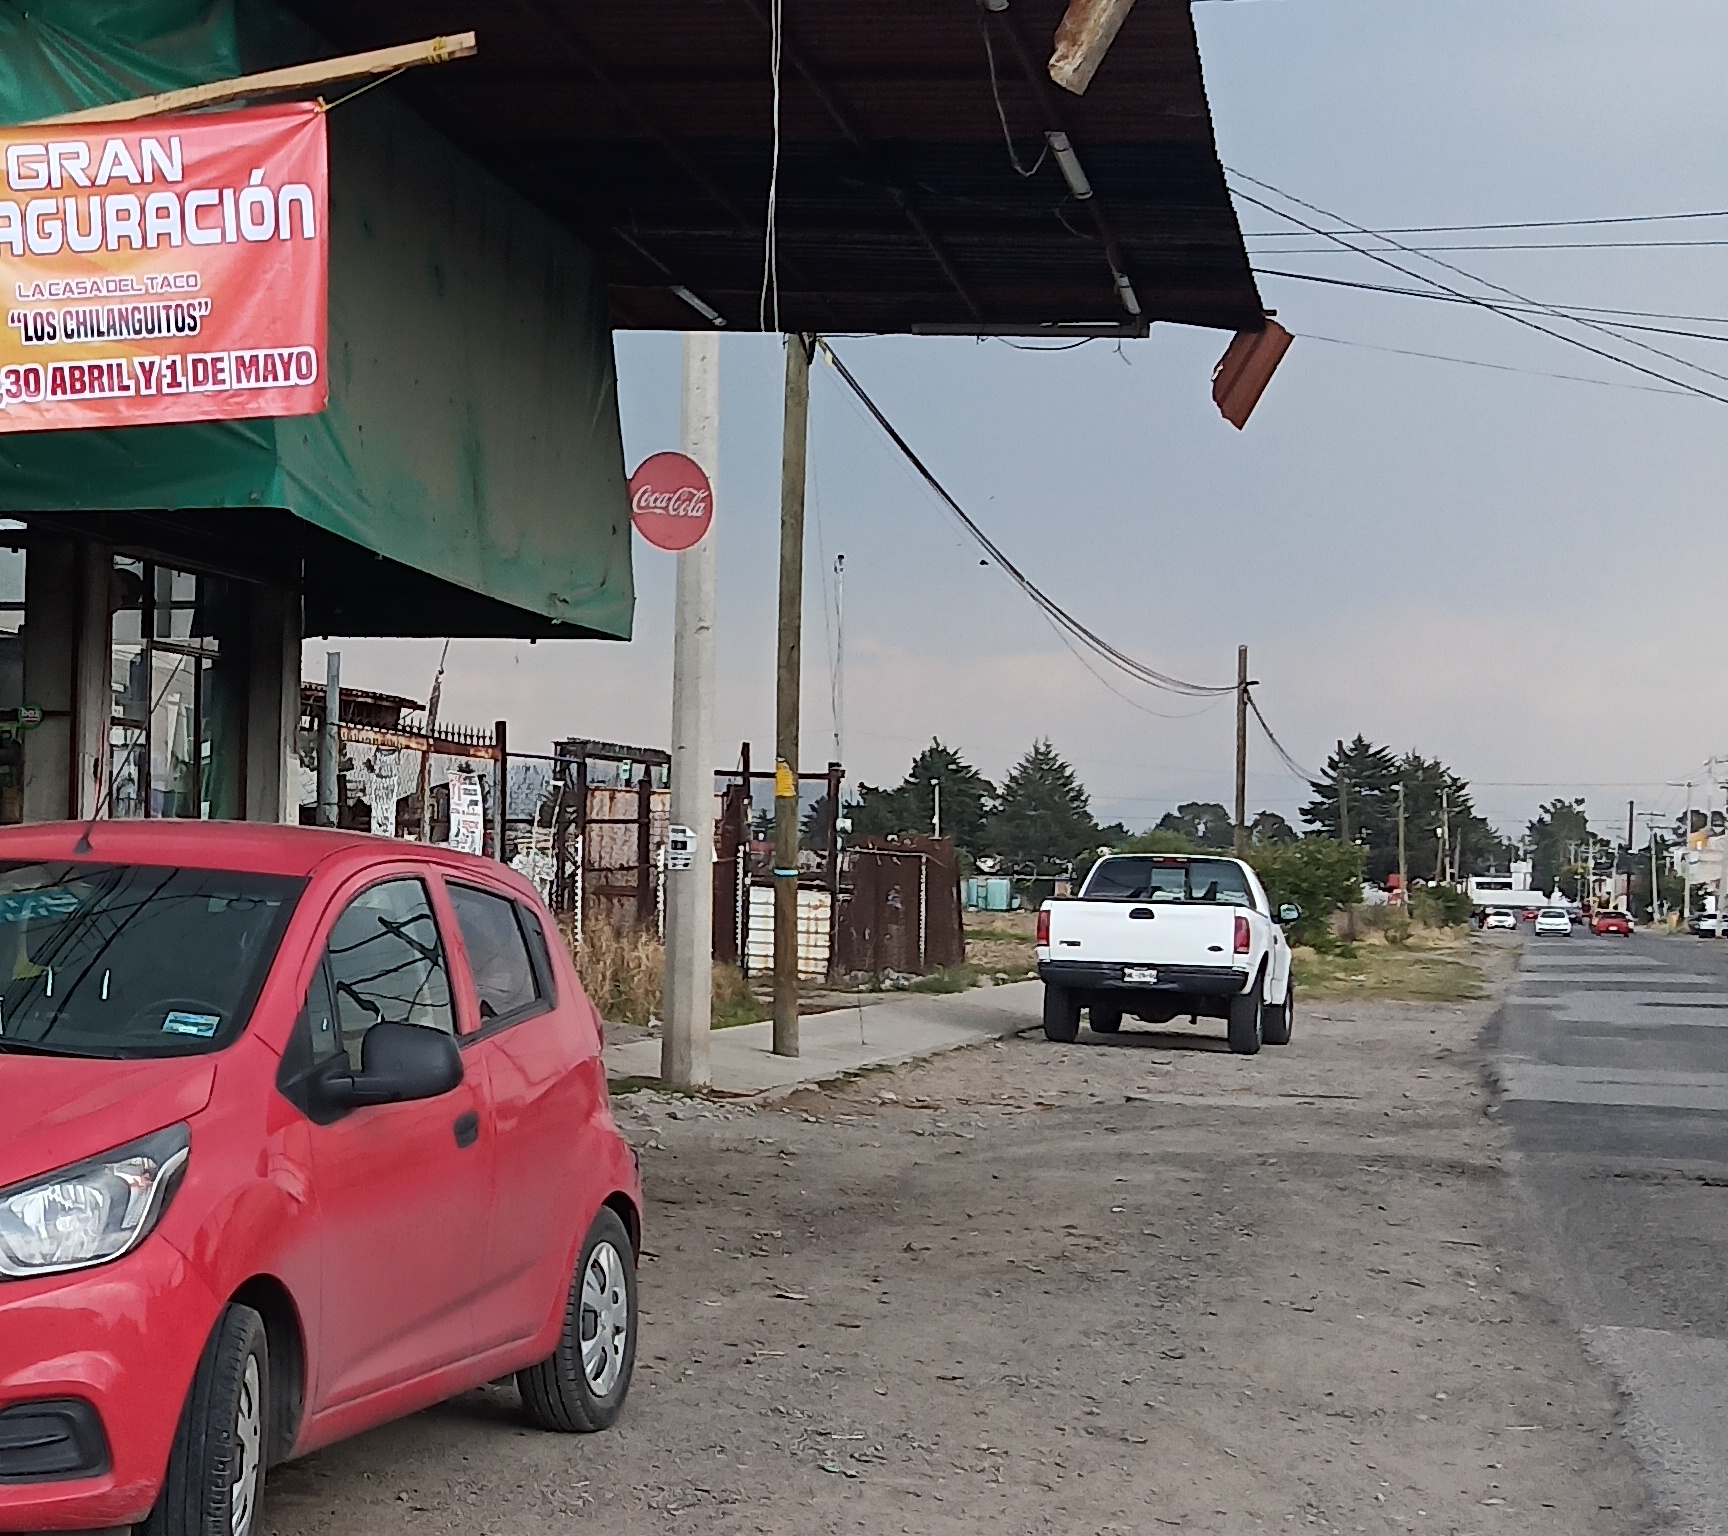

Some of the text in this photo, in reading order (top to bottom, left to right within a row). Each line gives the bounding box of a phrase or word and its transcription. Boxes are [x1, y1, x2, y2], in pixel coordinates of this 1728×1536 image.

[6, 136, 184, 191] GRAN
[17, 273, 199, 299] LA CASA DEL TACO
[49, 362, 132, 398] ABRIL
[136, 360, 156, 392] Y
[164, 359, 182, 390] 1
[190, 356, 227, 389] DE
[234, 350, 314, 385] MAYO
